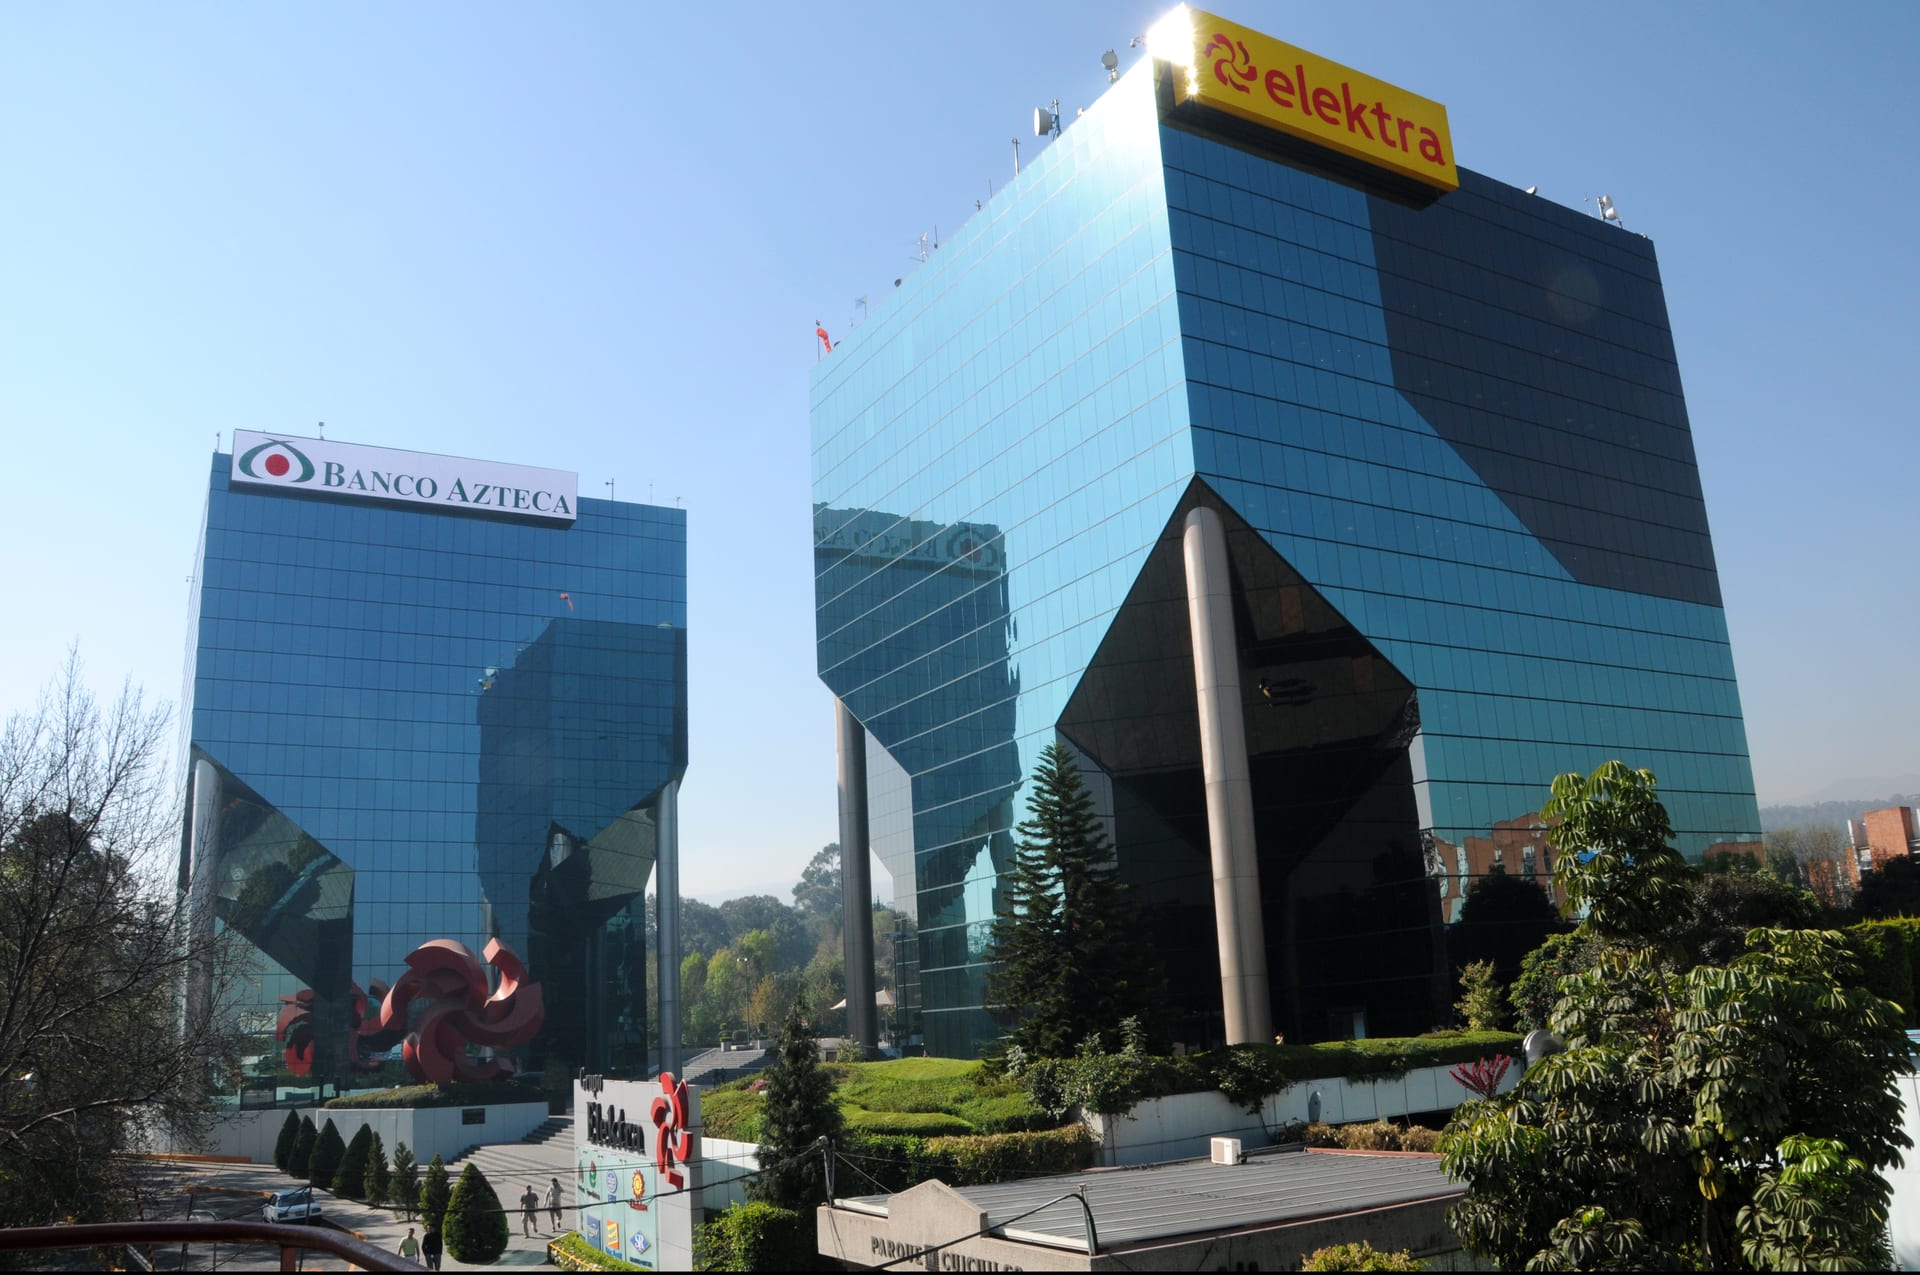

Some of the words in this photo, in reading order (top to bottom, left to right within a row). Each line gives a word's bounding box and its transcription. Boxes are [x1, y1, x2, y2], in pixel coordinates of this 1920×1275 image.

[1264, 64, 1446, 166] elektra
[322, 461, 438, 500] BANCO
[446, 477, 573, 515] AZTECA
[579, 1066, 604, 1100] Grupo
[586, 1102, 647, 1156] Elektra
[871, 1236, 924, 1266] PARQUE
